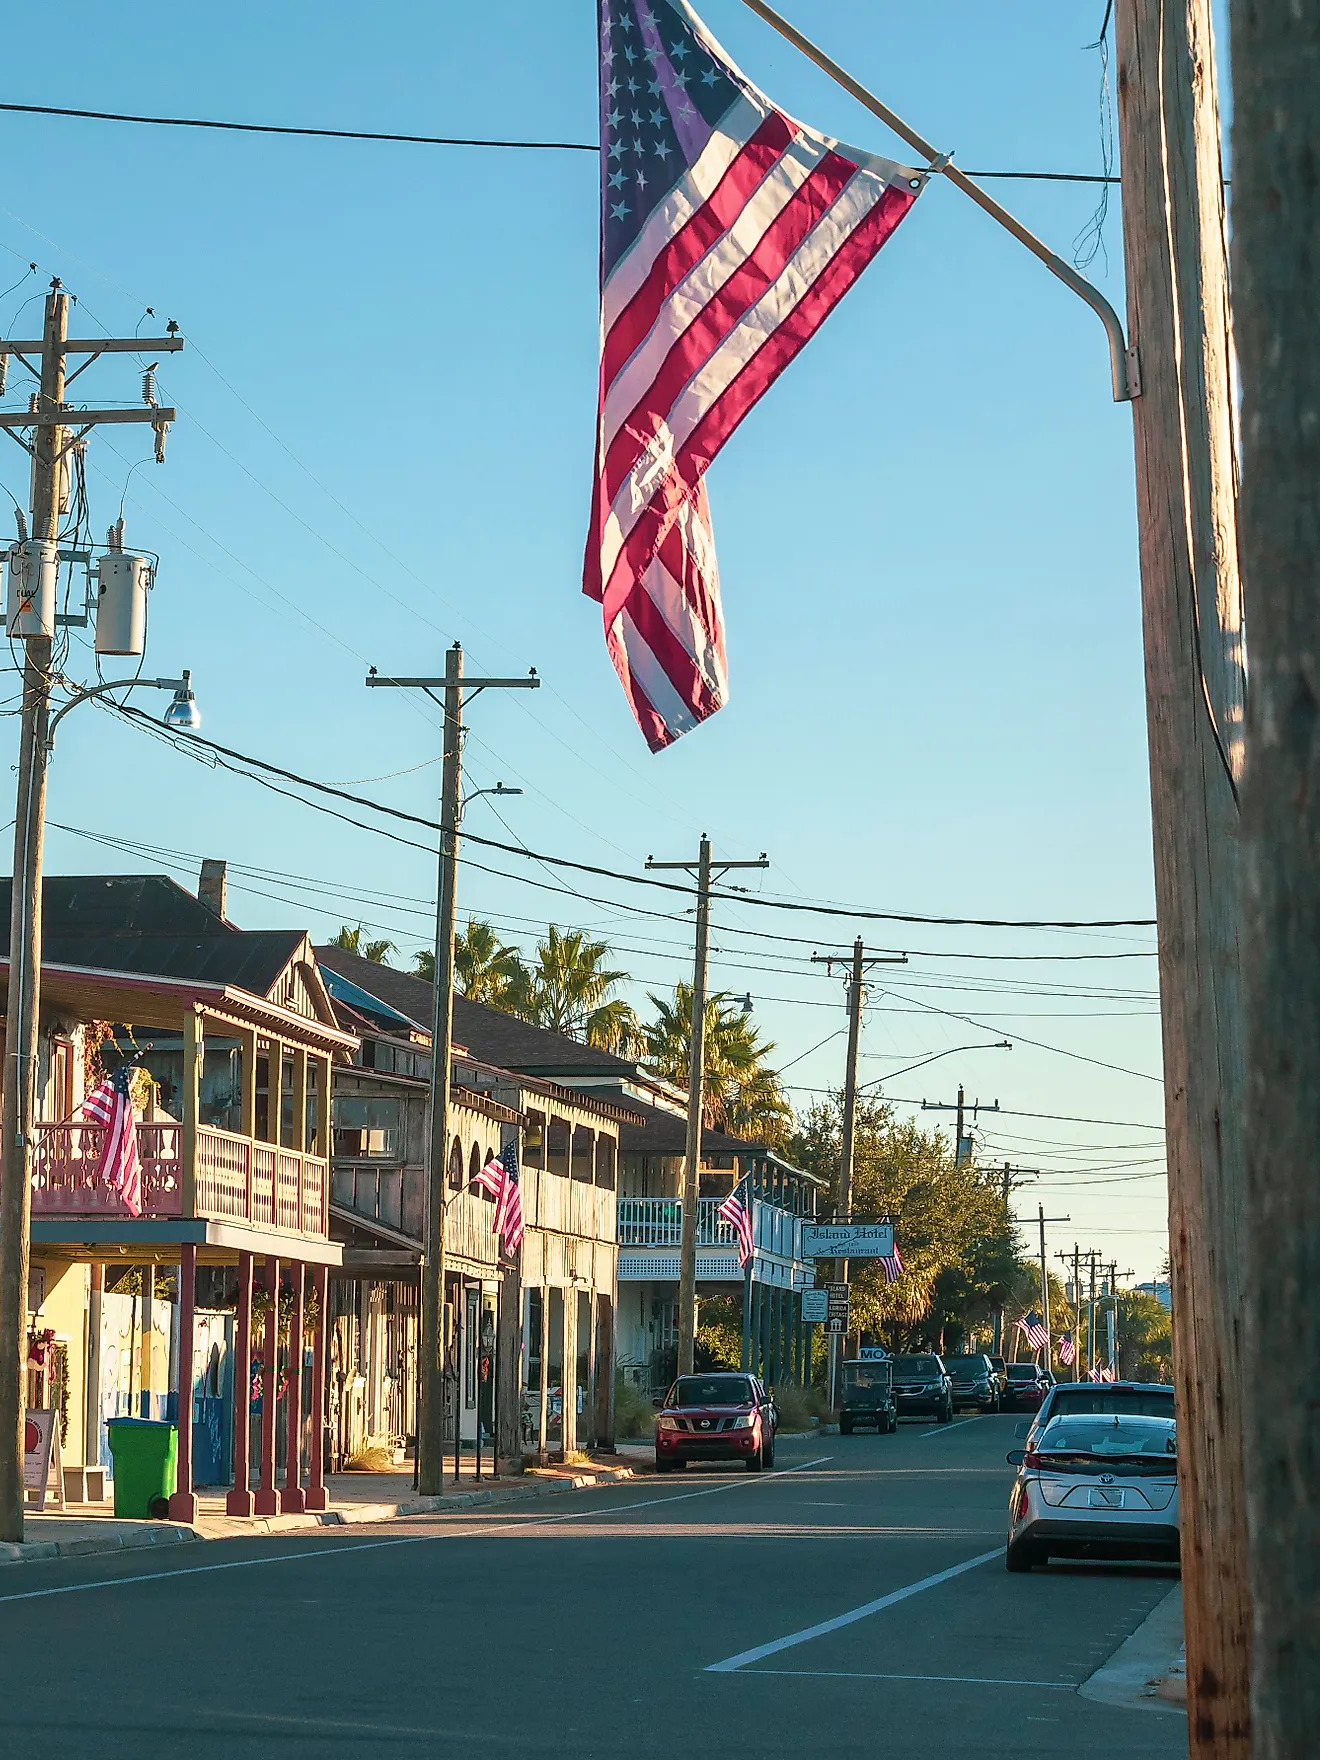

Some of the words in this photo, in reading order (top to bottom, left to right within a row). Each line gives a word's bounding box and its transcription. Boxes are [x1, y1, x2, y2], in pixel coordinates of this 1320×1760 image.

[808, 1227, 850, 1241] Island
[854, 1227, 888, 1240] Hotel
[830, 1246, 879, 1255] Restaurant
[860, 1349, 884, 1359] MO
